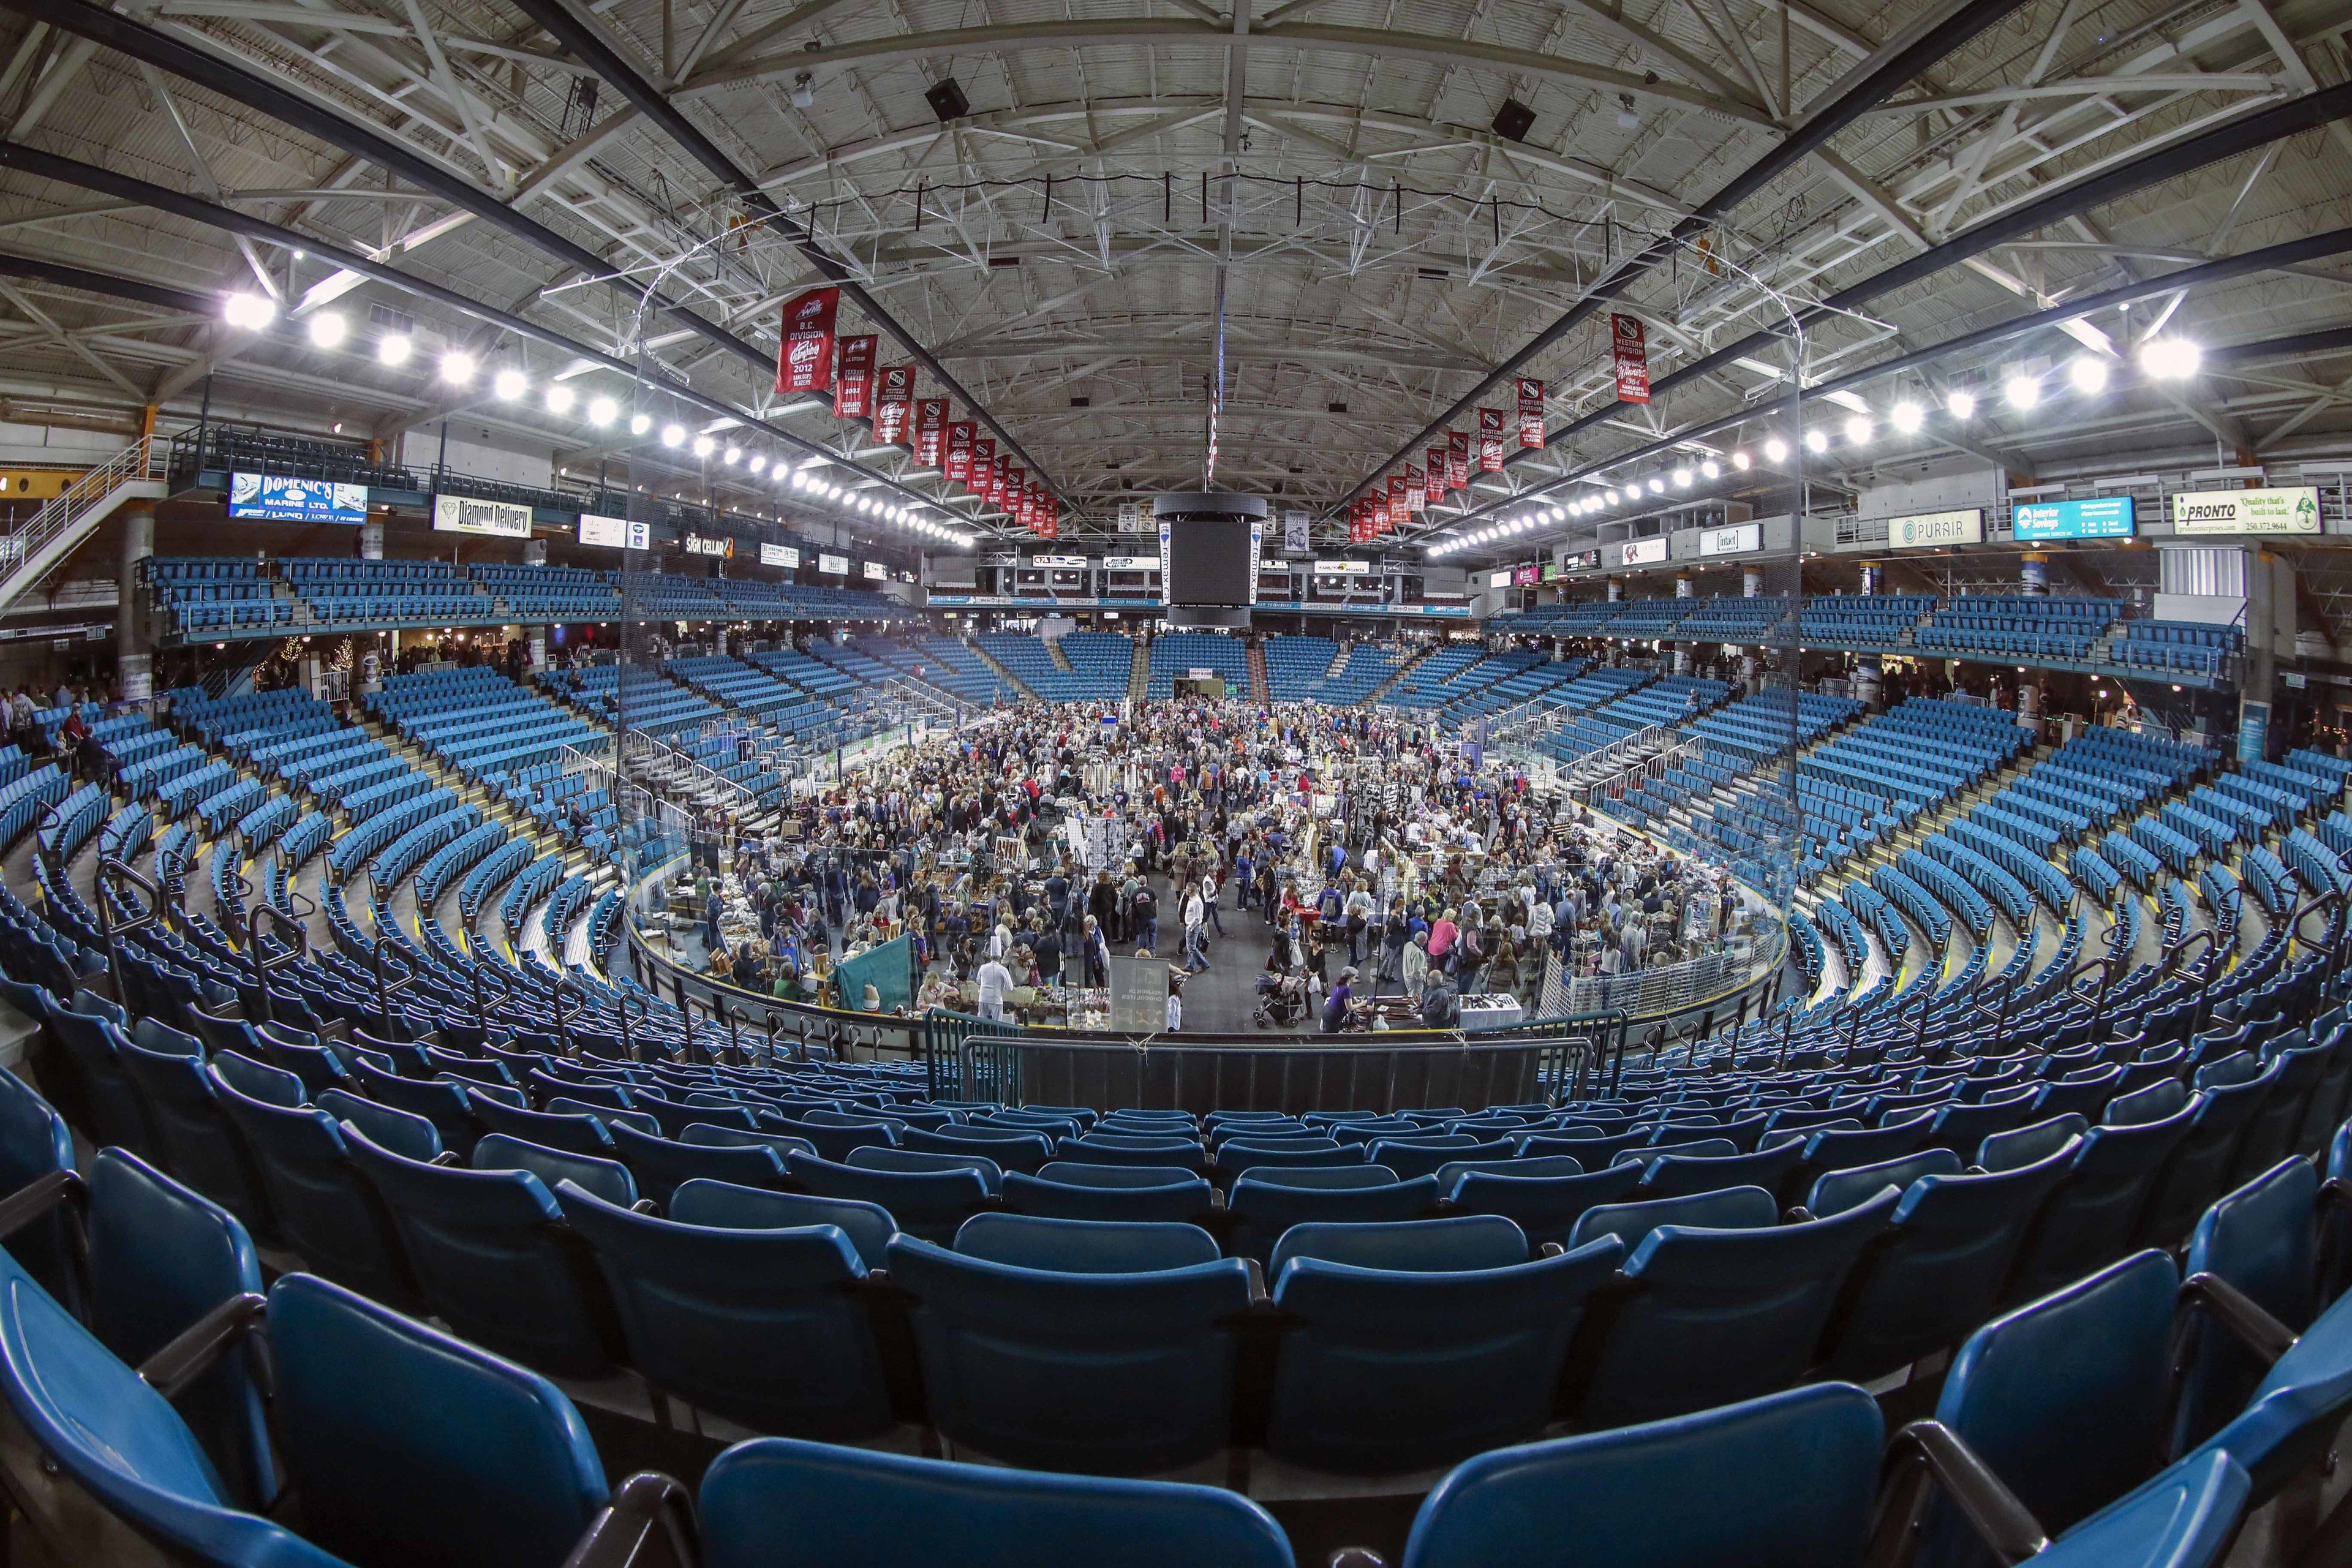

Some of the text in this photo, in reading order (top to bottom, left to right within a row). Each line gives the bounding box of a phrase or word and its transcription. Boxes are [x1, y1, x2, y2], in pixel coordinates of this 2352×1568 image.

[790, 330, 824, 341] DIVISION
[1616, 338, 1643, 349] WESTERN
[1617, 345, 1643, 355] DIVISION
[794, 364, 813, 373] 2012
[1617, 366, 1645, 380] Winners
[263, 477, 332, 500] DOMENIC'S
[265, 499, 304, 508] MARINE
[2267, 496, 2284, 505] that's
[272, 511, 303, 520] LUND
[459, 500, 527, 532] Diamond Delivery
[2032, 508, 2059, 518] Interior
[2187, 504, 2236, 526] PRONTO
[2251, 507, 2266, 516] built
[1292, 517, 1303, 526] 28
[2032, 519, 2059, 530] Savings
[1918, 521, 1963, 538] PURAIR
[687, 537, 724, 556] SIGN CELLAR
[1250, 547, 1259, 600] remax.ca
